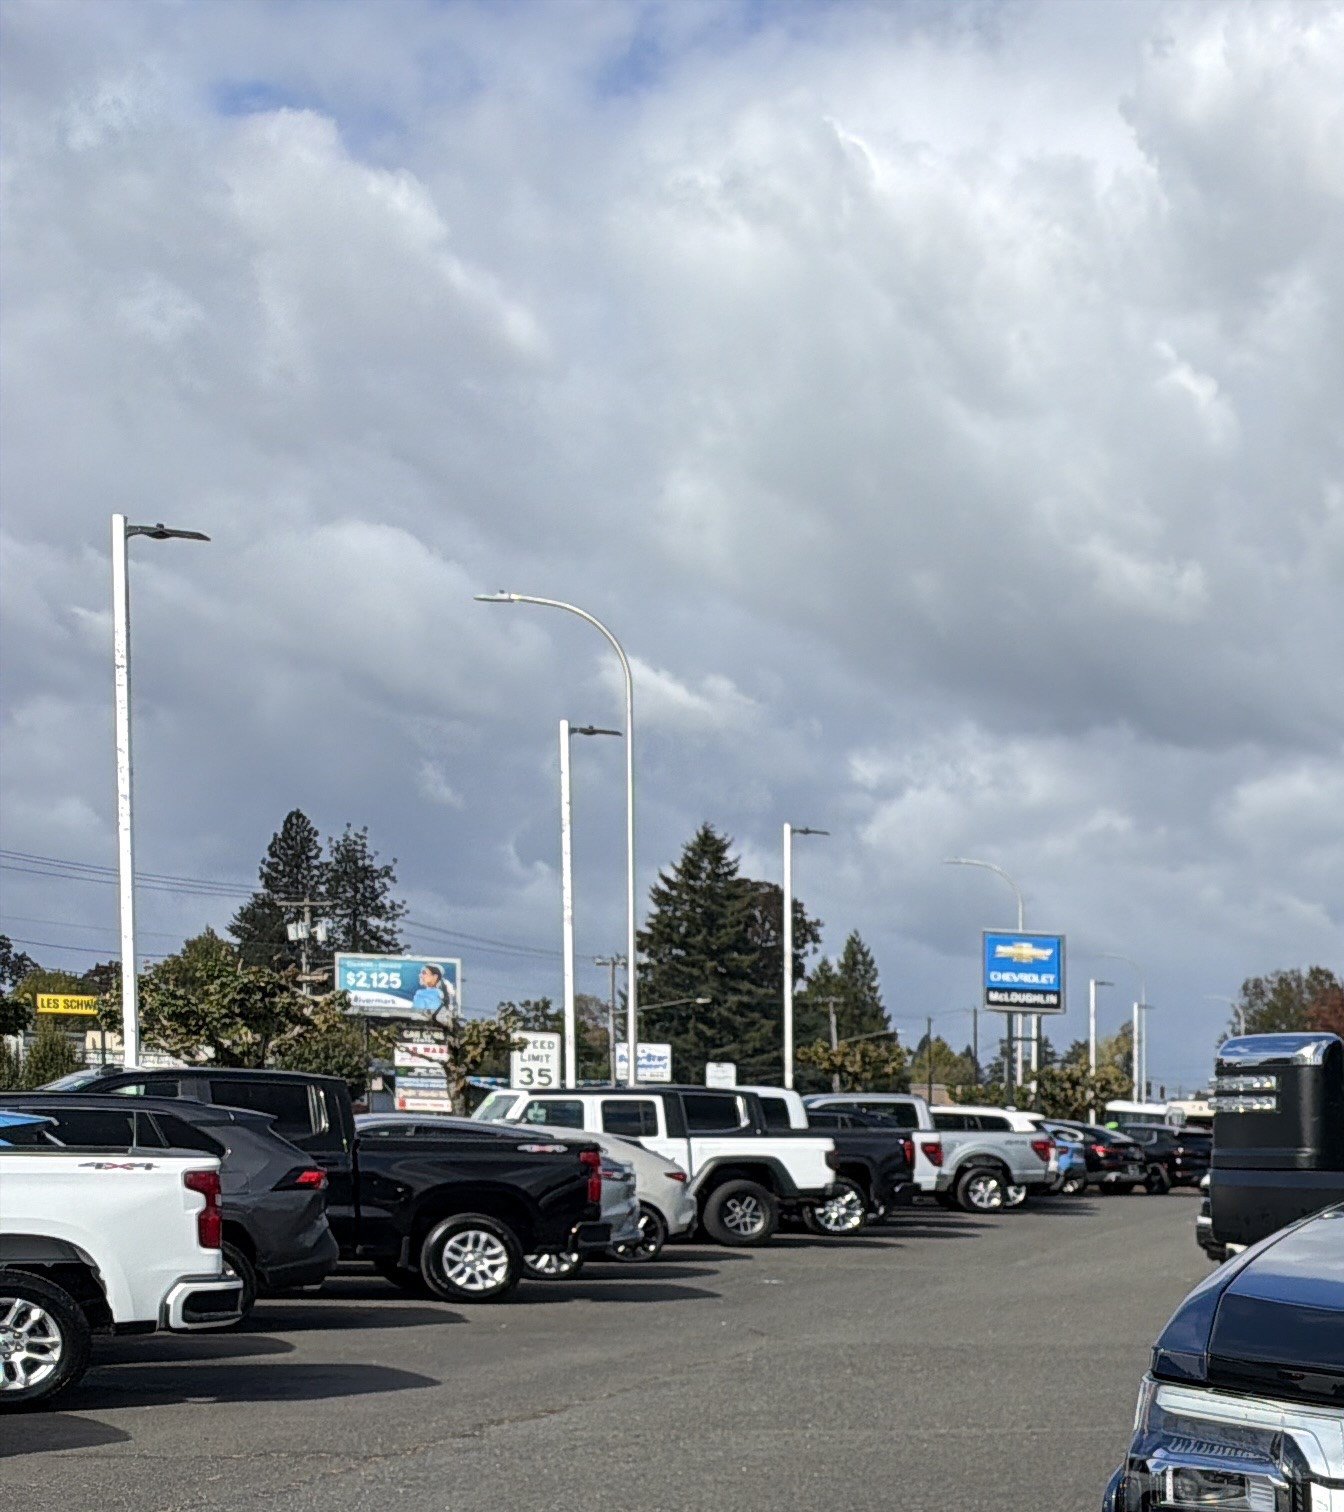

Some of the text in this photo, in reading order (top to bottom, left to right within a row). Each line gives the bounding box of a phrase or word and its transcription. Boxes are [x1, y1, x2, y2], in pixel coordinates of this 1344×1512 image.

[346, 970, 402, 989] $2,125
[989, 971, 1056, 985] CHEVROLET
[40, 998, 60, 1009] LES
[519, 1040, 555, 1049] PEED
[519, 1053, 552, 1063] LIMIT
[519, 1067, 553, 1087] 35
